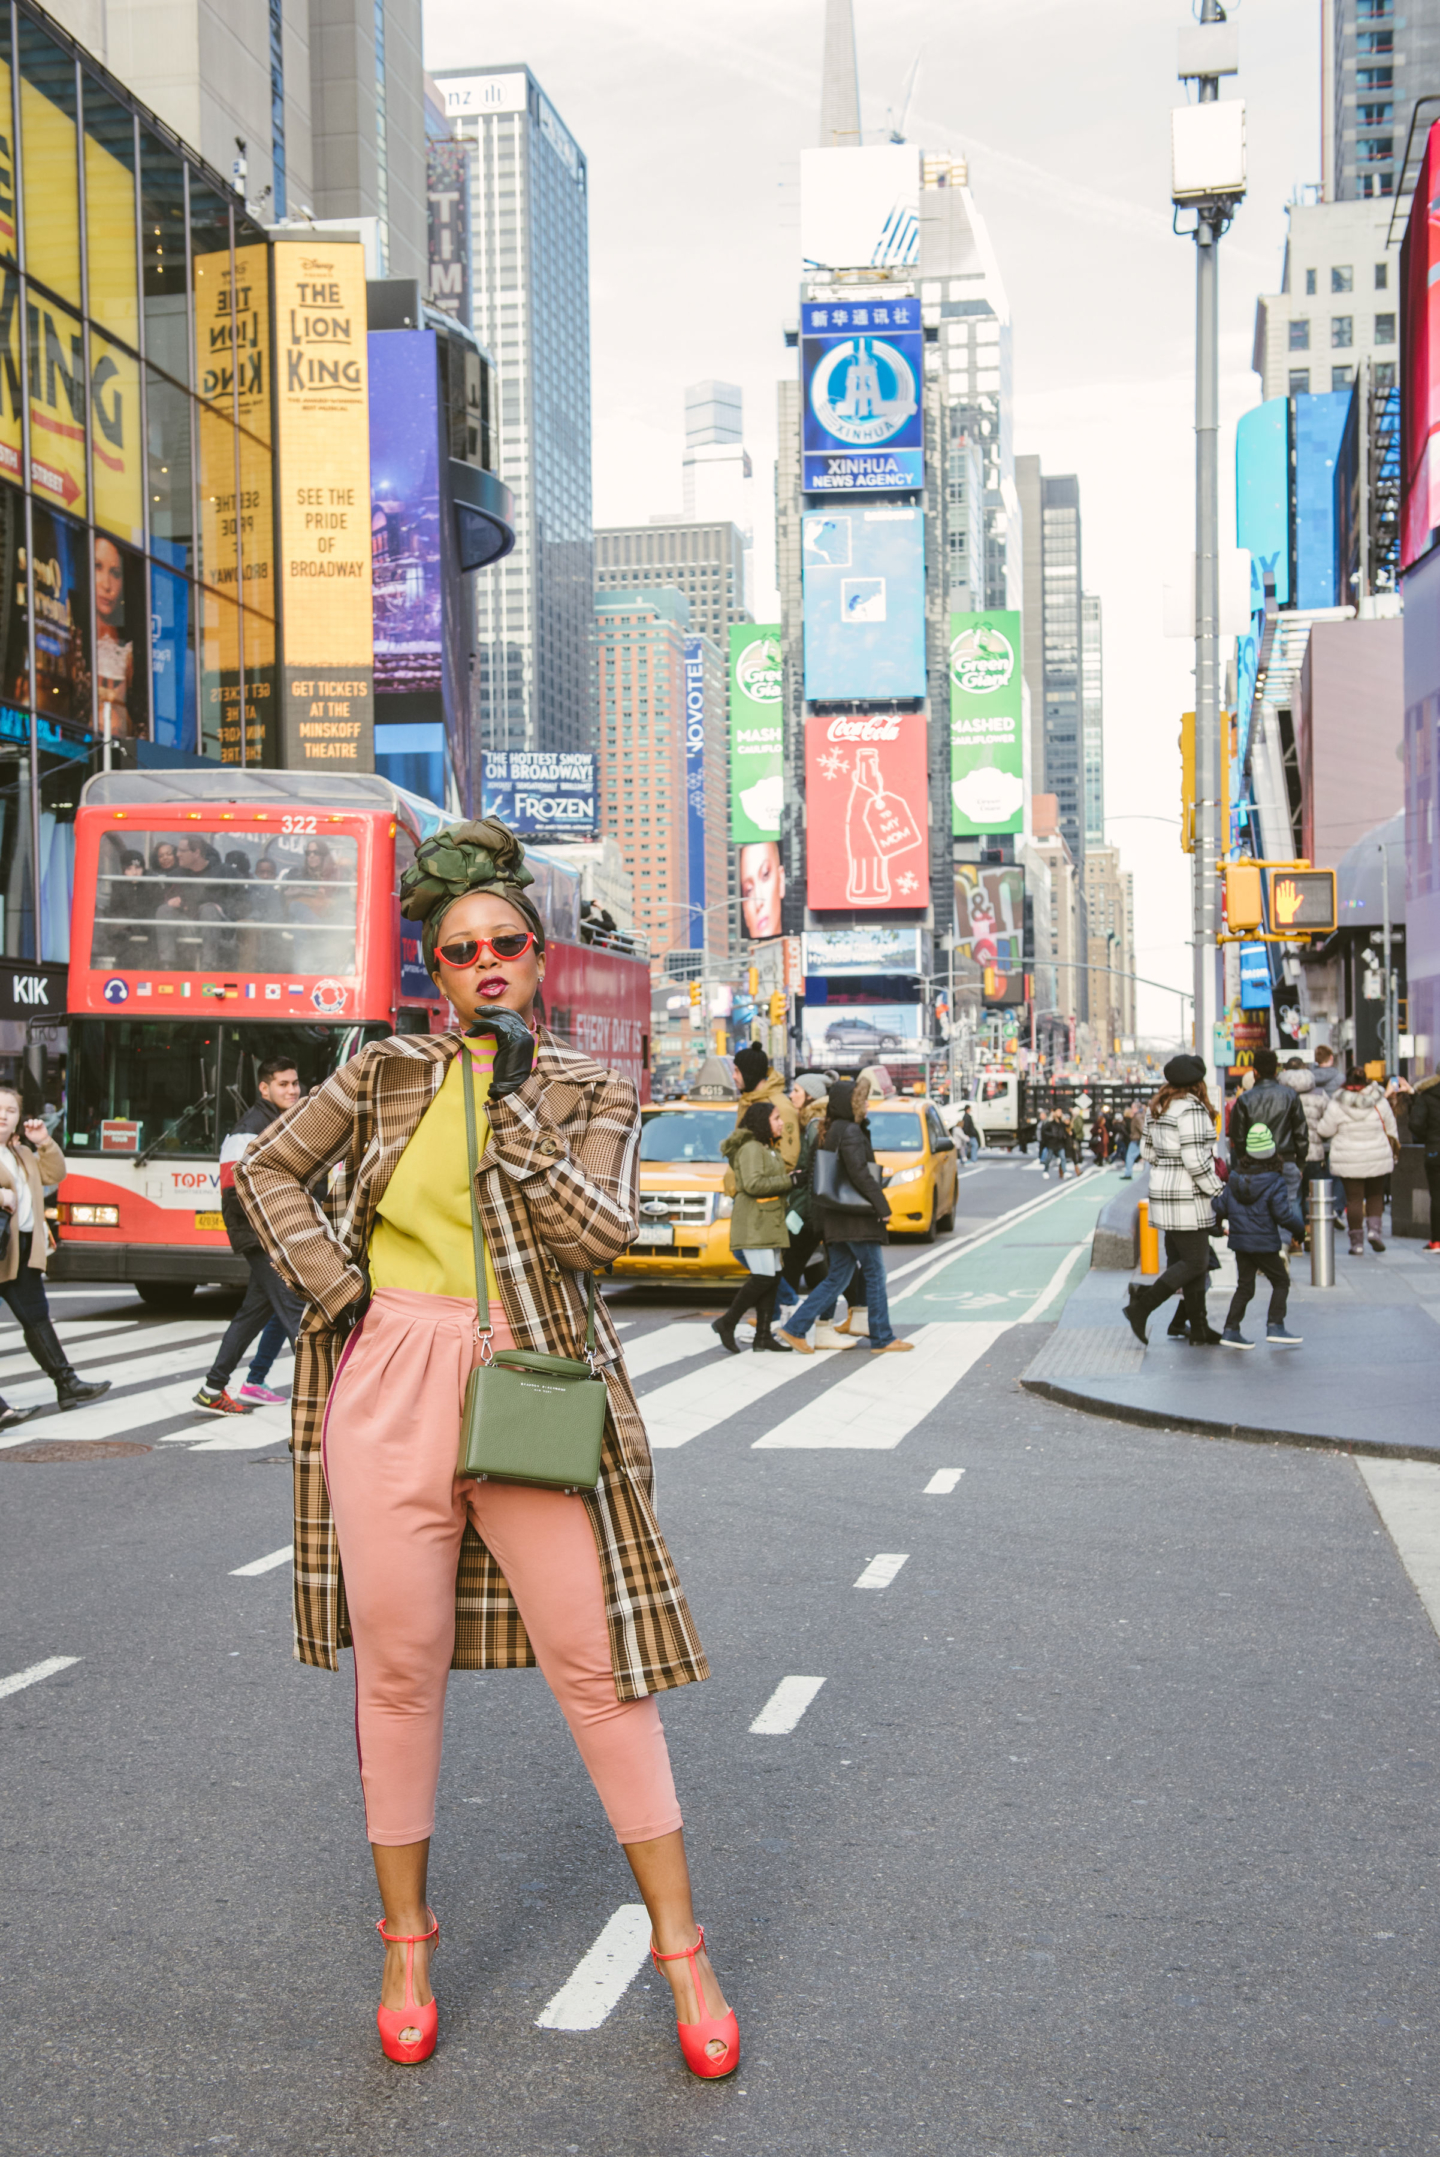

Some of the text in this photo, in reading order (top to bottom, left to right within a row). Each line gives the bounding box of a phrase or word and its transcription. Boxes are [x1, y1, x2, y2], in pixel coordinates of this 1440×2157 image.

[297, 283, 340, 303] THE
[291, 309, 350, 345] LION
[287, 349, 361, 391] KING
[835, 421, 895, 441] XINHUA
[828, 458, 898, 475] XINHUA
[812, 473, 914, 488] NEWS AGENCY
[297, 489, 355, 505] SEE THE
[306, 513, 348, 529] PRIDE
[318, 537, 336, 553] OF
[290, 561, 364, 578] BROADWAY
[955, 657, 1009, 673] Green
[962, 671, 1012, 688] Giant
[291, 681, 368, 697] GET TICKETS
[309, 702, 350, 717] AT THE
[684, 649, 704, 758] NOVOTEL
[300, 722, 362, 738] MINSKOFF
[304, 743, 357, 758] THEATRE
[487, 752, 593, 766] THE HOTTEST SNOW
[485, 764, 594, 780] ON BROADWAY!
[515, 793, 594, 822] FROZEN
[281, 815, 317, 834] 322
[880, 817, 899, 833] MY
[880, 827, 911, 848] MOM
[13, 975, 49, 1005] KIK
[576, 1013, 642, 1053] EVERY DAY IS
[700, 1085, 723, 1096] 6G15
